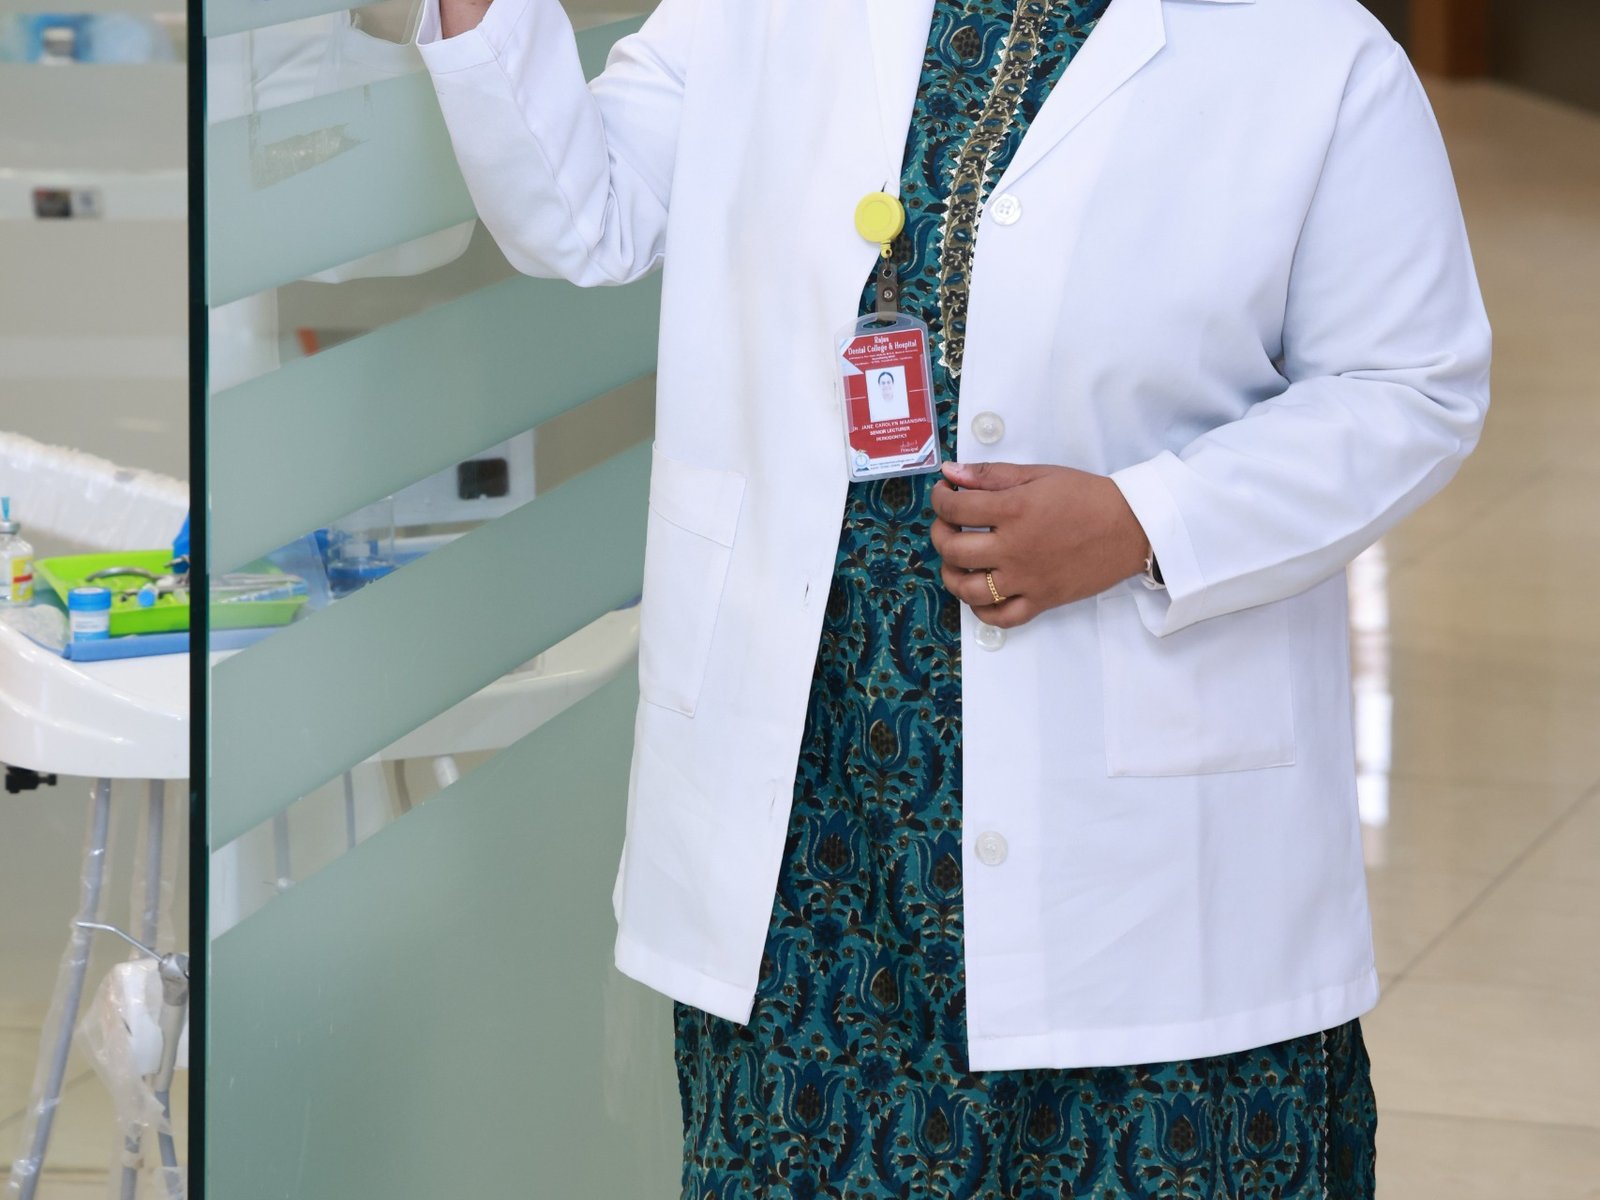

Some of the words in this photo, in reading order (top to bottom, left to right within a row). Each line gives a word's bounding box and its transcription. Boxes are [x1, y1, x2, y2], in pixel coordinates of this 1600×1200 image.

[848, 346, 866, 355] Dental
[866, 344, 887, 353] College
[894, 339, 917, 350] Hospital
[887, 426, 911, 434] LECTURER
